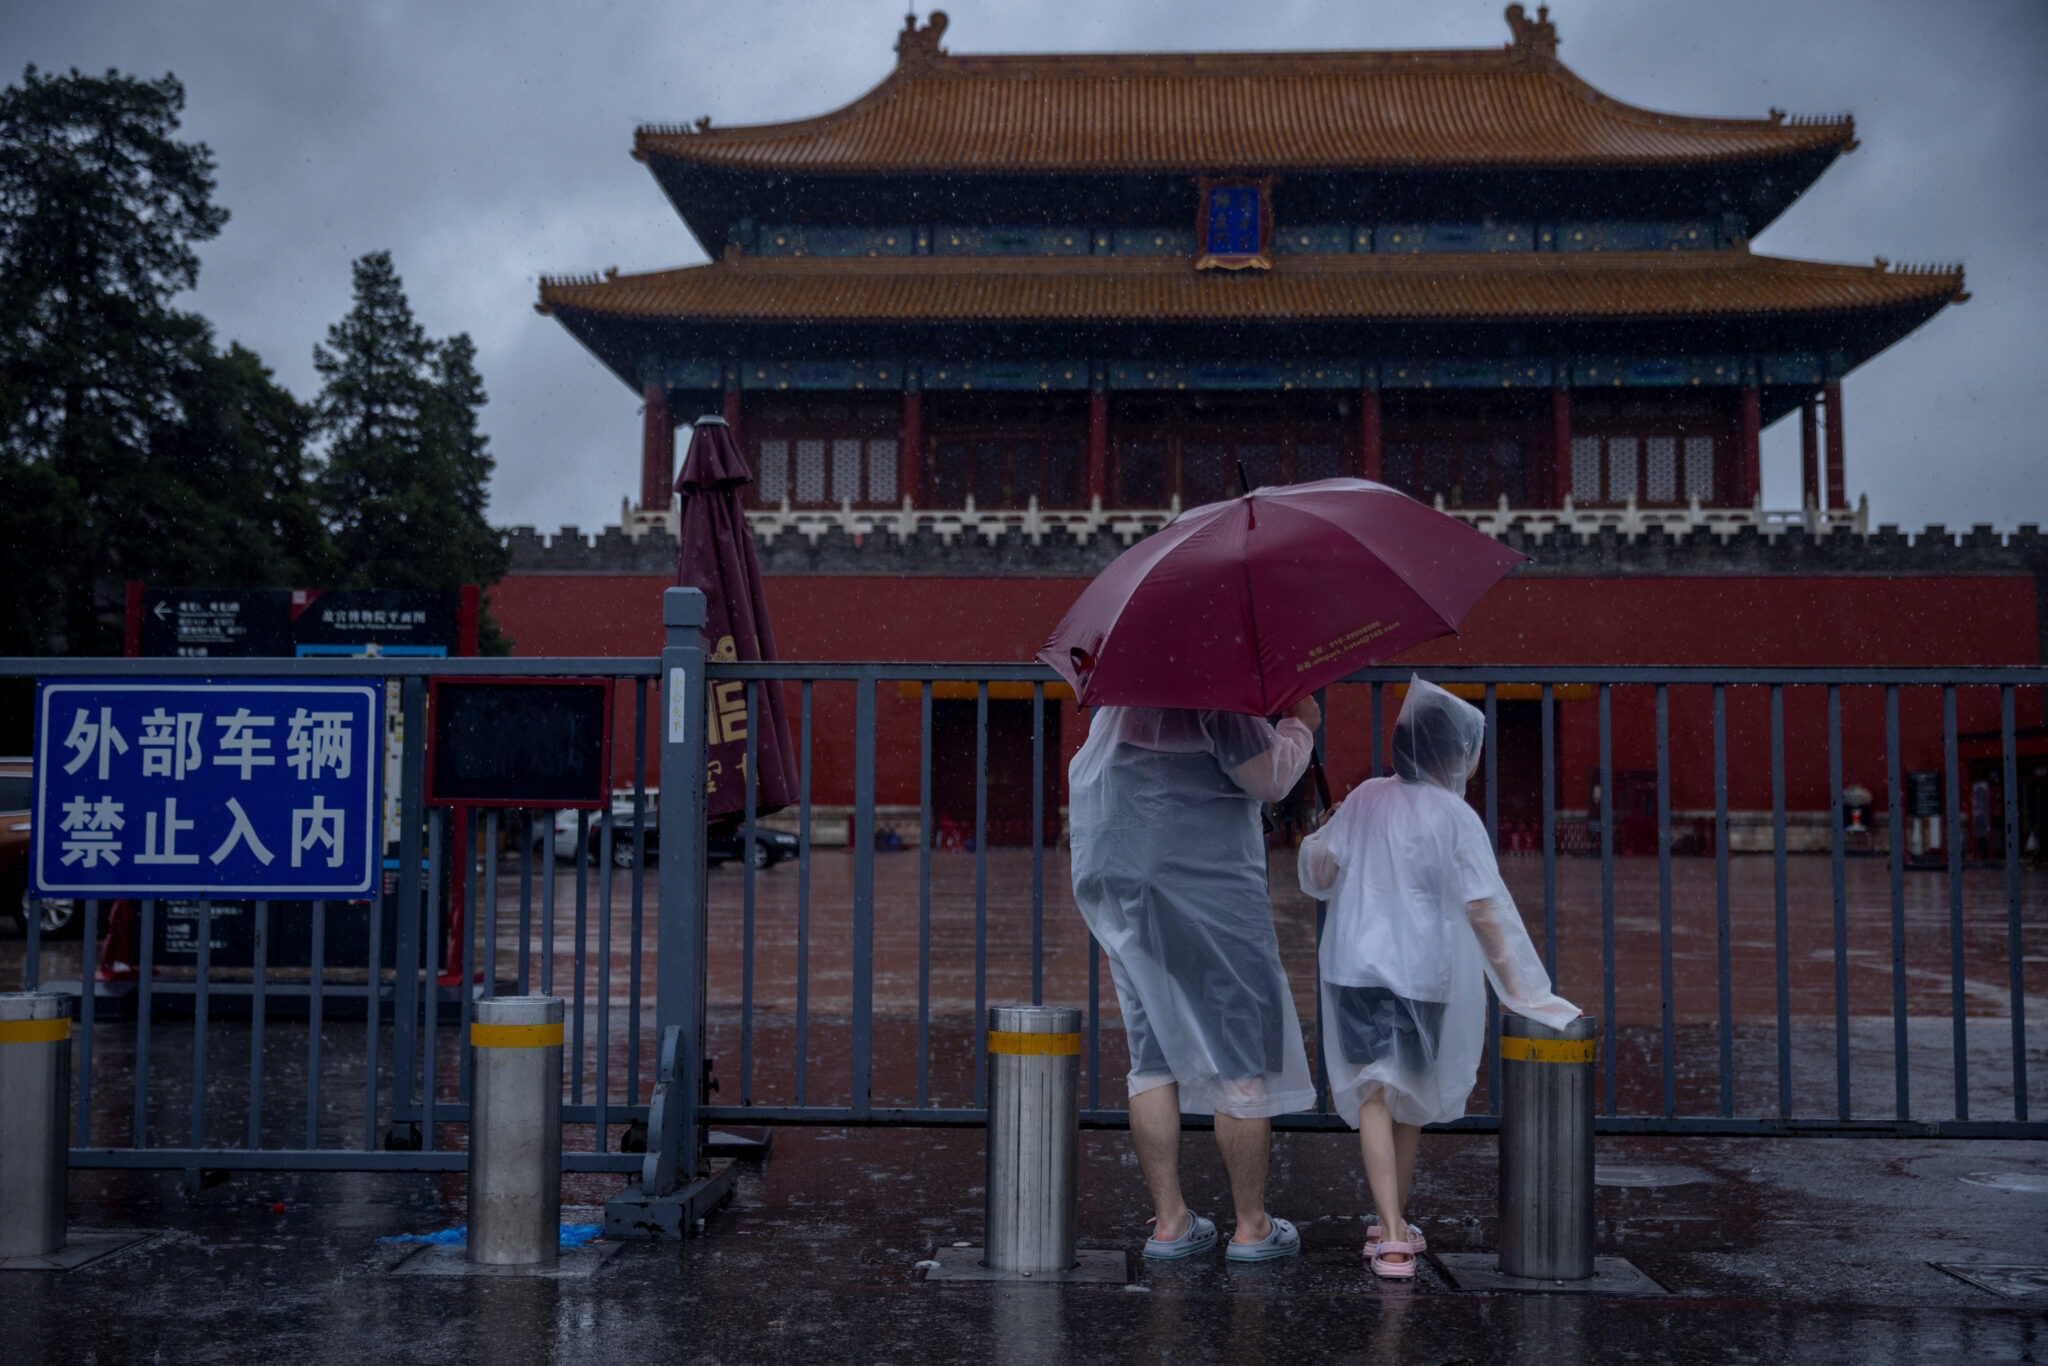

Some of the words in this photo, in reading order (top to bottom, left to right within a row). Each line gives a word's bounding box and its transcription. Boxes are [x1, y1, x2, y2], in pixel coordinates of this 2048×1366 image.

[63, 708, 353, 780] 外部车辆
[60, 796, 346, 868] 禁止入内
